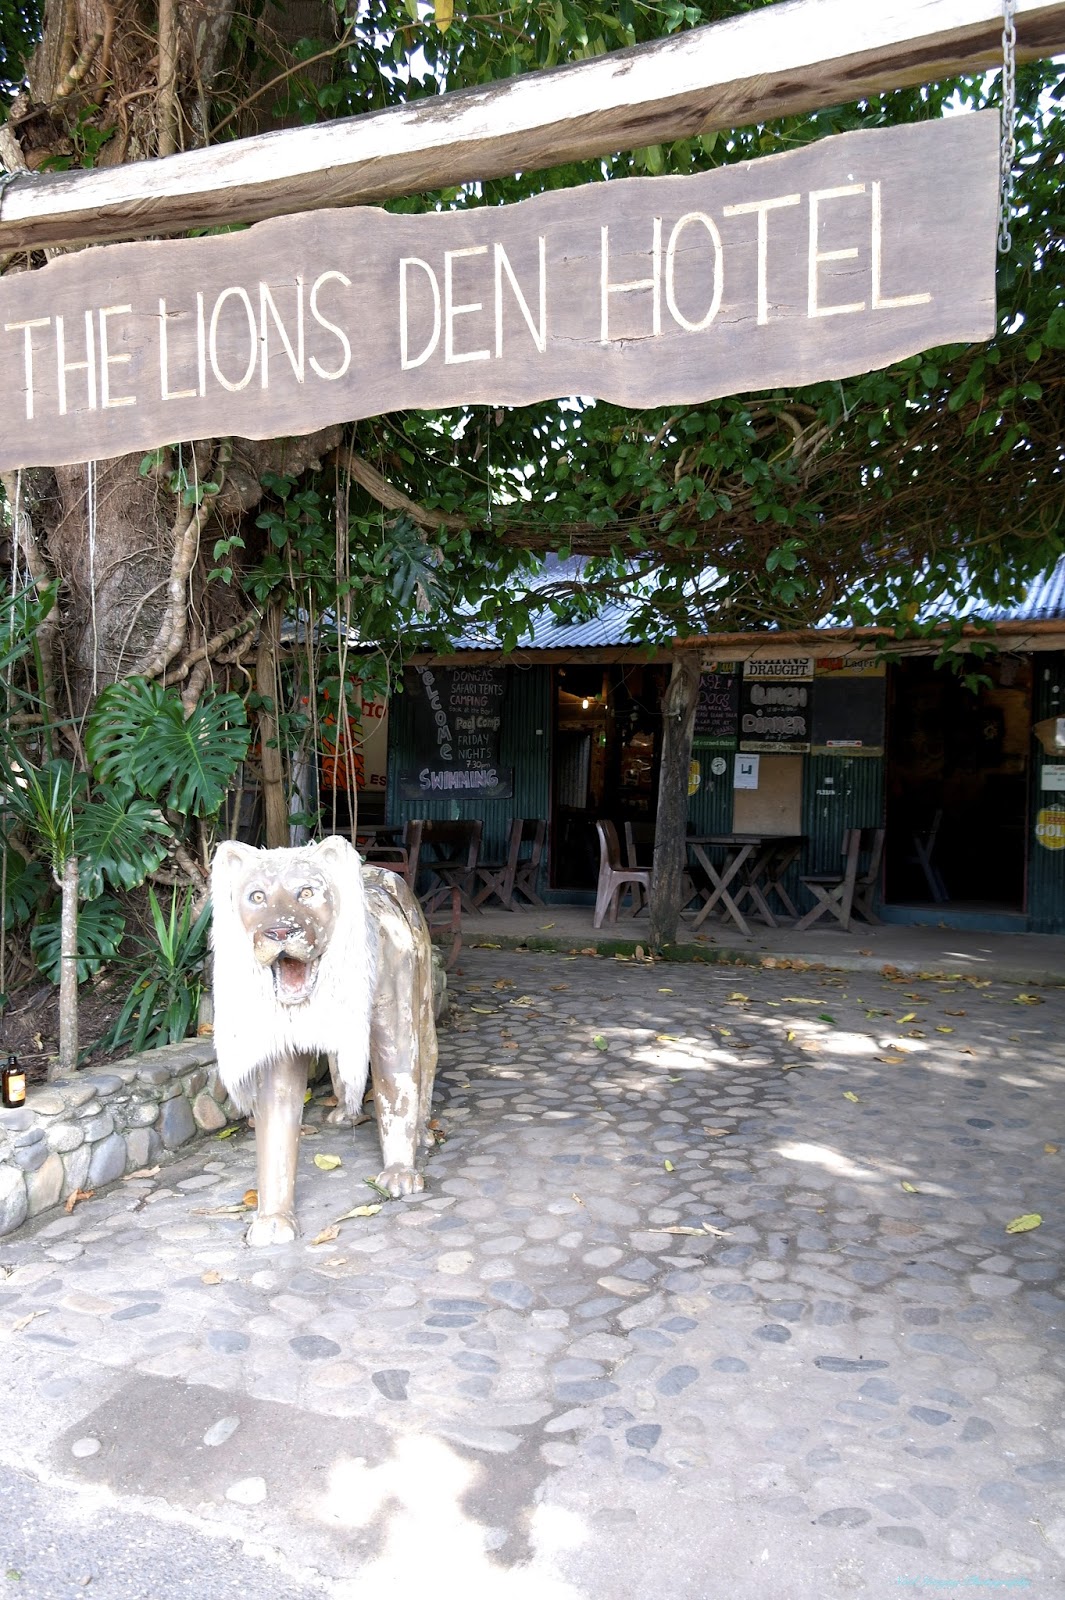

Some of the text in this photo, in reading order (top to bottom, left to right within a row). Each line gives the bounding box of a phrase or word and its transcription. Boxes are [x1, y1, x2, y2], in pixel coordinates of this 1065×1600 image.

[4, 180, 931, 419] THE LIONS DEN HOTEL
[453, 669, 494, 682] DONGAS
[749, 665, 808, 675] DRAUGHT
[450, 683, 504, 696] SAFARI TENTS
[449, 695, 489, 707] CAMPING
[455, 715, 501, 731] Pool Comp
[457, 734, 489, 746] FRIDAY
[458, 747, 492, 760] NIGHTS
[419, 767, 499, 791] SWIMMING
